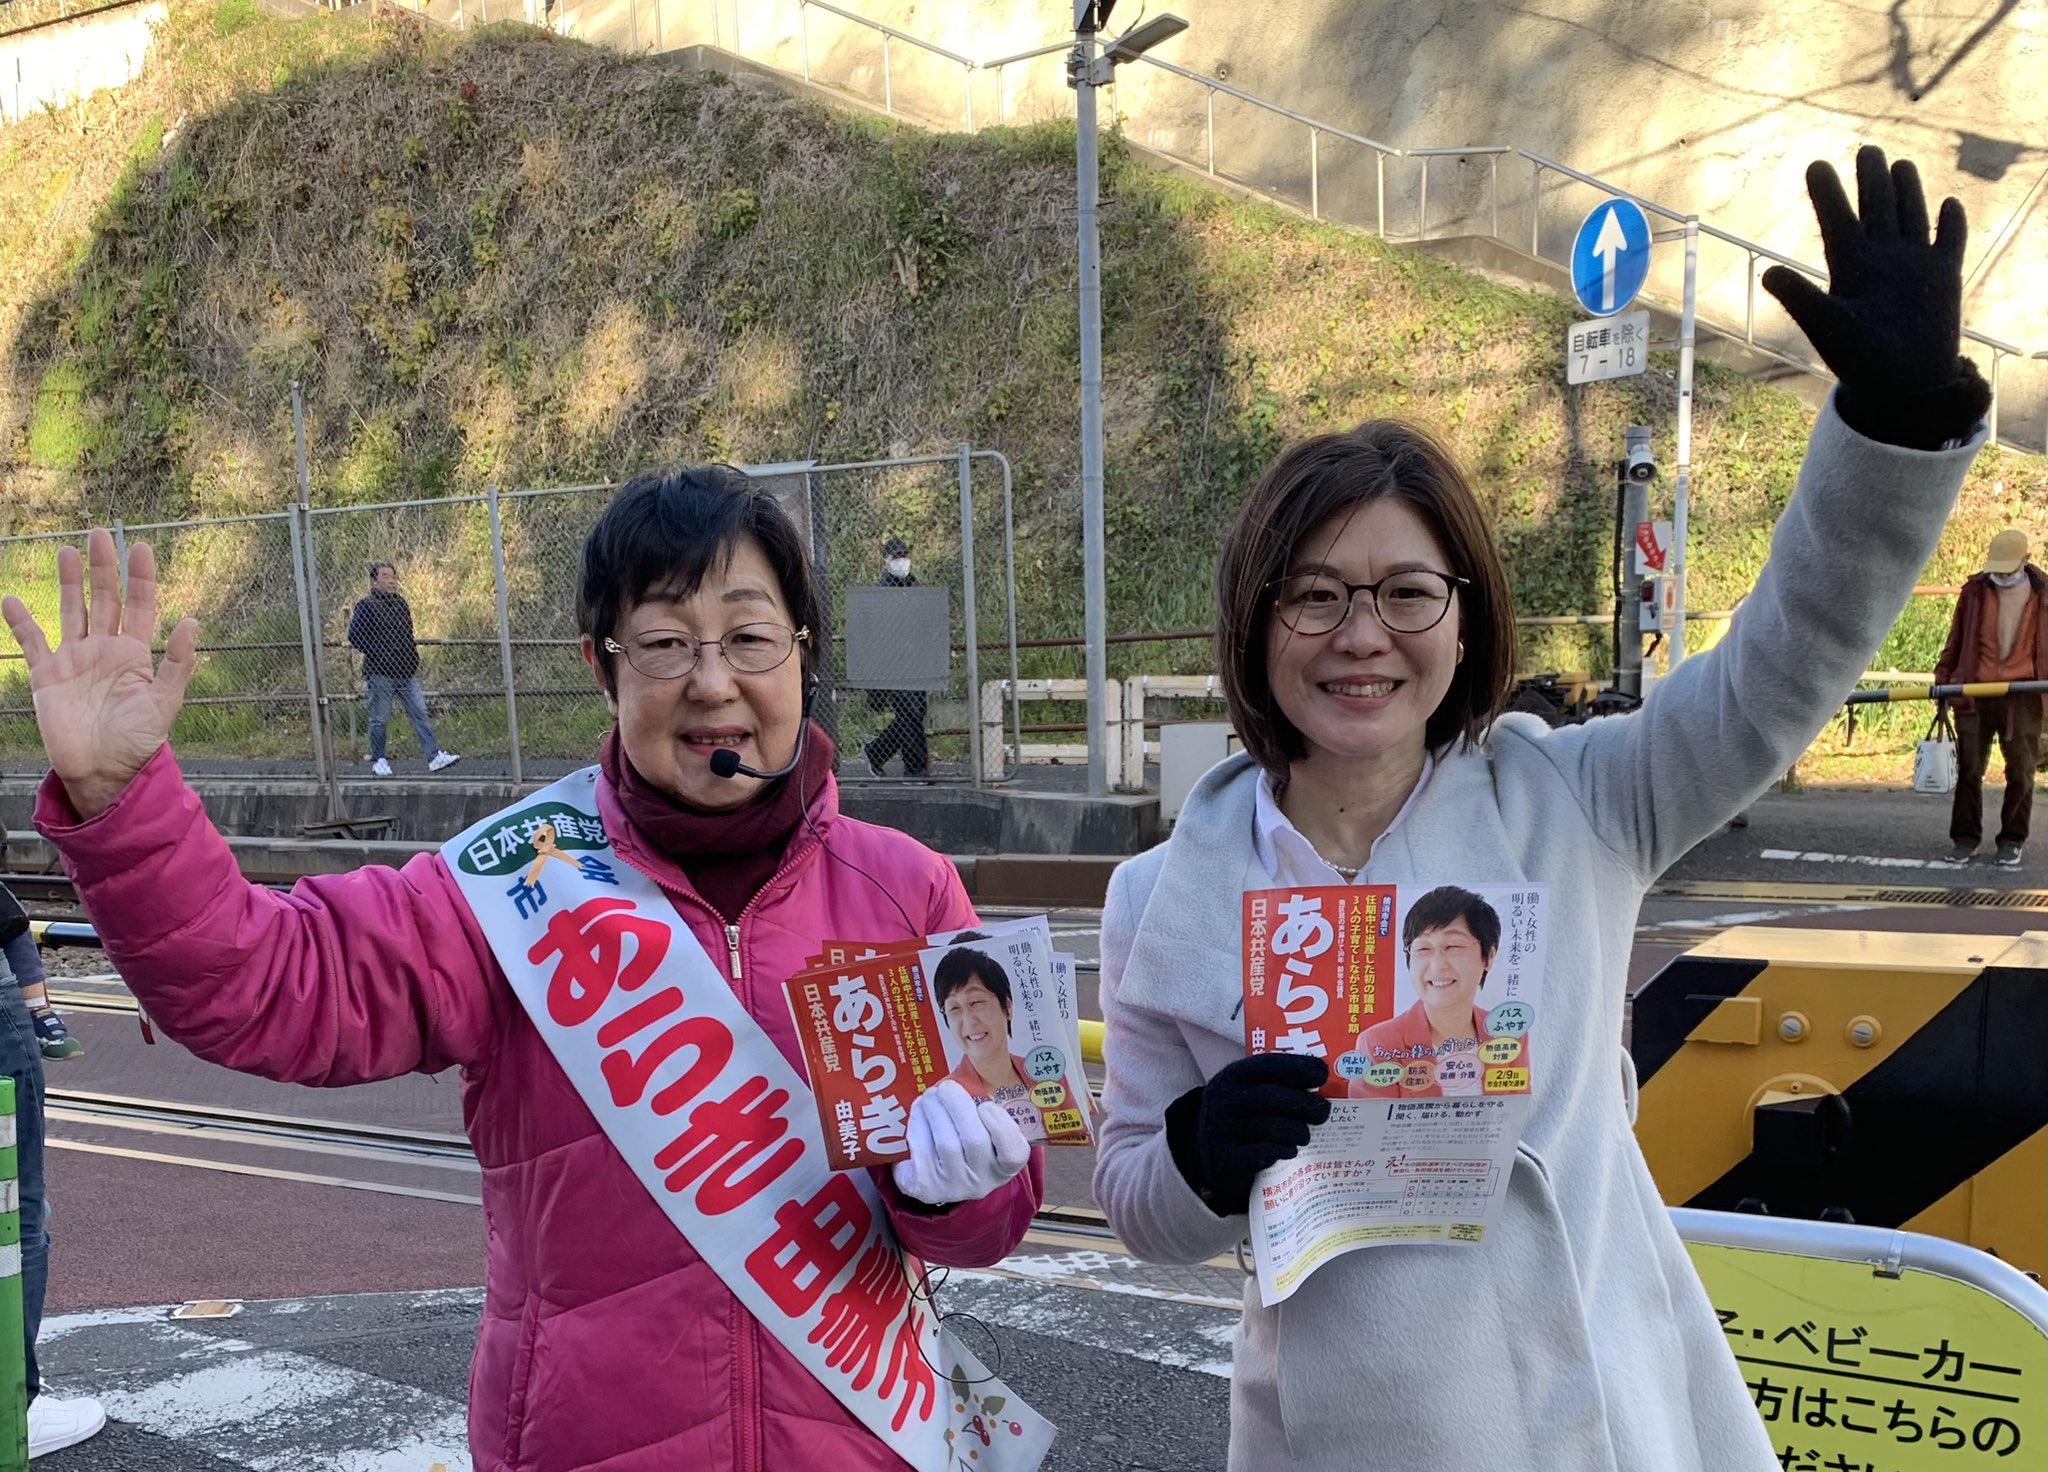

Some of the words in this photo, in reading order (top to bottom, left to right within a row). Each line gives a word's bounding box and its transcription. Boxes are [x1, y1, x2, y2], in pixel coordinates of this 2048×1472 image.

[1573, 323, 1644, 353] 自転車を除く
[1250, 898, 1268, 996] 日本共産党
[1507, 892, 1524, 997] 明るい未来を一緒に
[1524, 891, 1540, 953] 働く女性の
[1008, 943, 1043, 1042] 明るい未来を一緒に
[1020, 942, 1044, 999] 働く女性の
[1056, 962, 1070, 1020] 働く女性の
[1493, 1020, 1527, 1032] ふやす
[1500, 1008, 1523, 1018] バス
[803, 983, 842, 1073] 日本共産党
[835, 1099, 862, 1161] 由美子
[829, 975, 909, 1155] あらき
[1034, 1063, 1061, 1076] ふやす
[1035, 1051, 1055, 1063] バス
[1446, 1061, 1473, 1070] 安心の
[1747, 1377, 2022, 1458] 方はこちらの
